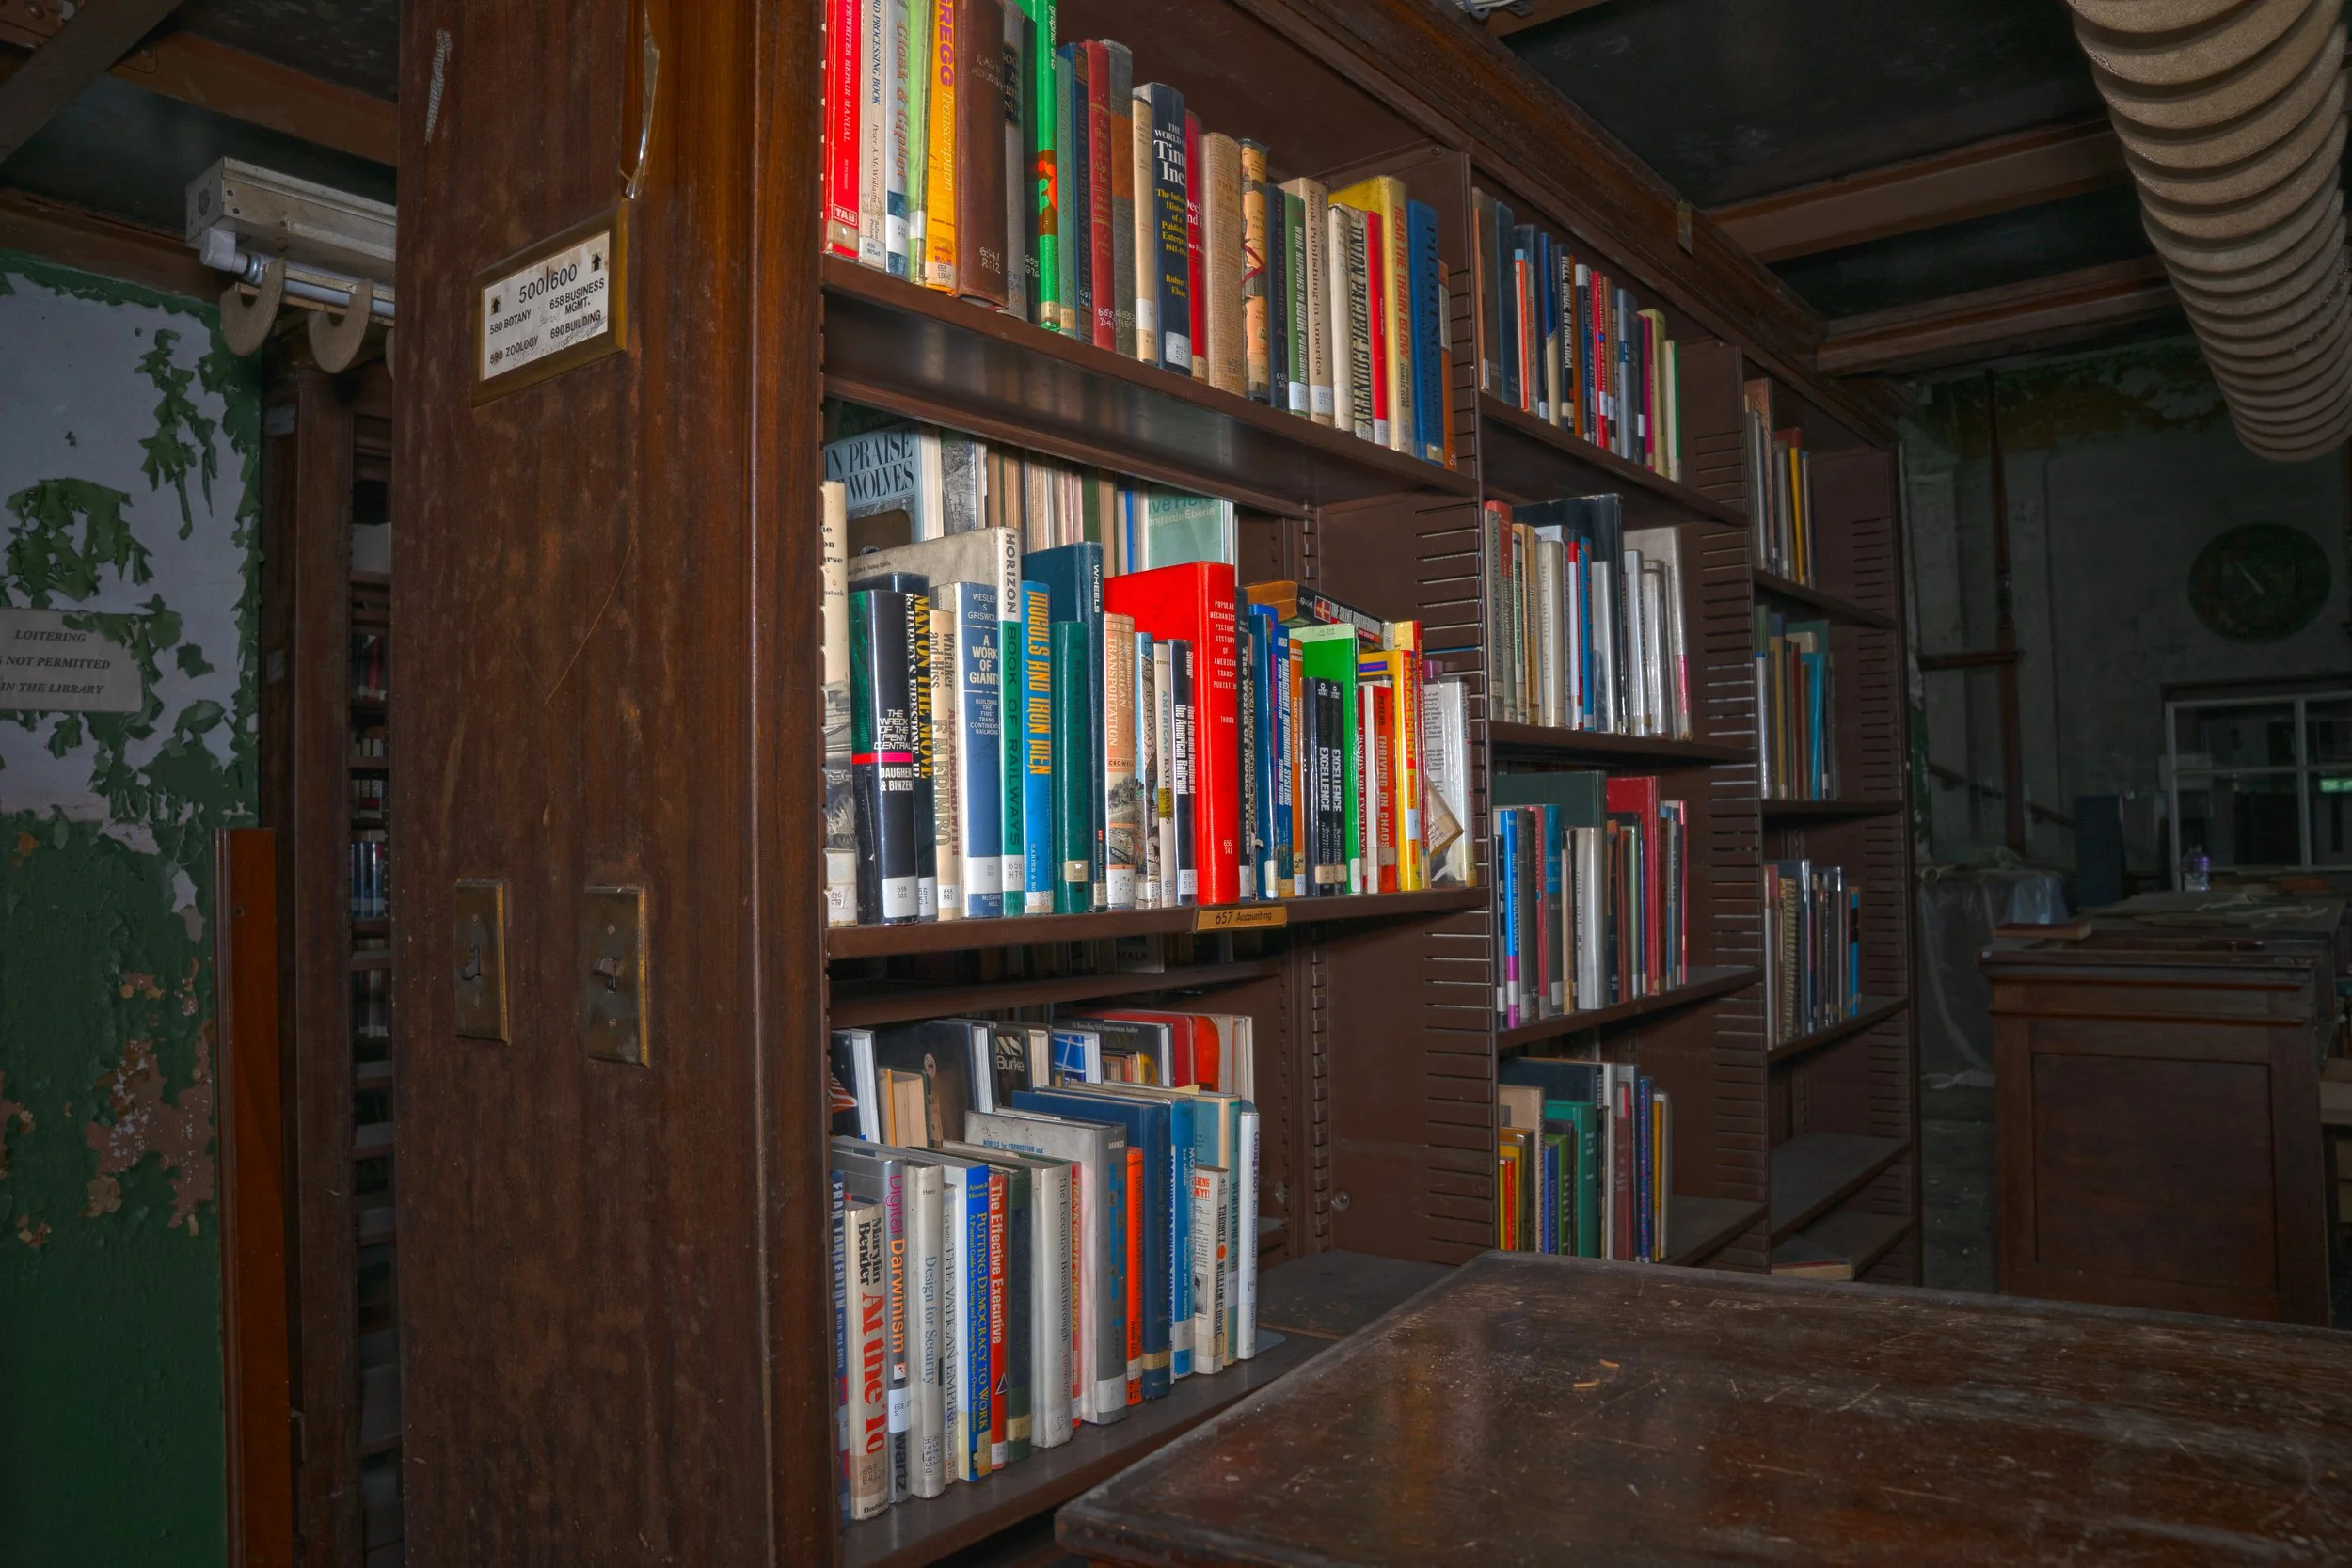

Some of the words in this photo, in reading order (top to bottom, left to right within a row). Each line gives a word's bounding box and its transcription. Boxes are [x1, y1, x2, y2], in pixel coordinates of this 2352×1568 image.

[1048, 4, 1058, 46] graphic
[872, 16, 882, 76] PROCESSING
[896, 22, 909, 84] Cloak
[871, 76, 882, 105] BOOK
[896, 87, 909, 105] &
[843, 101, 851, 142] MANUAL
[871, 123, 880, 144] Peter
[1154, 129, 1182, 145] WORLD
[1167, 122, 1182, 135] THE
[940, 92, 954, 191] Transcription
[1156, 188, 1169, 199] The
[834, 206, 857, 223] TAB
[1394, 206, 1406, 245] HEAR
[1295, 225, 1304, 249] WHAT
[1350, 226, 1367, 279] UNION
[1295, 250, 1305, 291] HAPPENS
[1311, 226, 1320, 298] Publishing
[1395, 245, 1406, 272] THE
[1562, 256, 1571, 281] WELL
[549, 296, 564, 310] 658
[565, 278, 604, 303] BUSINESS
[565, 297, 591, 315] MGMT.
[1351, 279, 1370, 345] PACIFIC
[1396, 272, 1408, 318] TRAIN
[1563, 283, 1572, 310] MADE
[489, 321, 503, 336] 580
[504, 309, 532, 329] BOTANY
[549, 325, 564, 340] 690
[565, 310, 601, 334] BUILDING
[1296, 301, 1307, 331] BOOK
[489, 350, 503, 365] 590
[505, 335, 539, 358] ZOOLOGY
[1298, 331, 1308, 384] PUBLISHING
[1397, 319, 1409, 360] BLOW
[1354, 347, 1373, 430] COUNTRY
[825, 445, 843, 482] IN
[849, 428, 913, 472] PRAISE
[849, 460, 915, 502] WOLVES
[1184, 507, 1216, 520] Eberle
[1006, 532, 1017, 614] HORIZON
[914, 594, 930, 634] MAN
[972, 592, 996, 604] WESLEY
[1210, 610, 1235, 622] MECHANICS
[1214, 600, 1234, 610] POPULAR
[14, 630, 87, 642] LOITERING
[983, 634, 990, 645] A
[1026, 590, 1050, 657] MOGULS
[1215, 623, 1235, 632] PICTURE
[1215, 635, 1235, 644] HISTORY
[6, 656, 35, 667] NOT
[37, 657, 111, 669] PERMITTED
[916, 638, 930, 668] ON
[930, 631, 940, 657] and
[943, 632, 956, 690] Whitaker
[972, 646, 997, 659] WORK
[1007, 626, 1017, 686] BOOK
[931, 660, 940, 689] Hiss
[979, 658, 992, 671] OF
[1026, 659, 1050, 692] AND
[1118, 637, 1127, 708] AMERICAN
[1186, 650, 1195, 679] Stover
[1217, 669, 1234, 677] TRANS-
[0, 682, 16, 691] IN
[19, 682, 46, 693] THE
[49, 684, 104, 694] LIBRARY
[917, 675, 933, 717] THE
[1106, 637, 1118, 746] TRANSPORTATION
[1243, 678, 1251, 726] World
[1281, 657, 1291, 712] MANAGEMENT
[879, 717, 909, 726] WRECK
[887, 708, 904, 718] THE
[1008, 699, 1018, 726] OF
[1026, 697, 1051, 734] IRON
[1144, 689, 1154, 758] RAILWAYS
[1175, 705, 1187, 718] the
[1405, 657, 1417, 762] MANAGEMENT
[873, 741, 912, 751] CENTRAL
[880, 726, 893, 735] OF
[894, 725, 909, 734] THE
[882, 734, 907, 742] PENN
[1175, 719, 1188, 758] American
[1282, 713, 1292, 768] INFORMATION
[920, 722, 934, 780] MOVE
[1027, 739, 1051, 775] MEN
[1378, 734, 1388, 788] THRIVING
[880, 782, 886, 791] &
[949, 743, 958, 812] ABOARD
[1176, 759, 1189, 795] Railroad
[1243, 747, 1251, 797] Model
[1284, 768, 1293, 806] SYSTEMS
[1320, 747, 1330, 812] EXCELLENCE
[1331, 749, 1342, 813] EXCELLENCE
[1008, 738, 1021, 846] RAILWAYS
[1379, 790, 1389, 808] ON
[1380, 808, 1390, 848] CHAOS
[1009, 862, 1024, 870] 656
[1215, 911, 1234, 925] 657
[1235, 911, 1272, 922] Accounting
[997, 1055, 1025, 1072] Burke
[832, 1182, 844, 1220] FRAN
[886, 1175, 904, 1236] Digital
[991, 1182, 1003, 1210] The
[1059, 1200, 1068, 1256] Executive
[1218, 1204, 1227, 1237] THEORY
[858, 1220, 870, 1287] Bender
[871, 1217, 882, 1284] Marylin
[977, 1212, 987, 1274] PUTTING
[991, 1214, 1004, 1275] Effective
[833, 1225, 846, 1308] TARKENTON
[922, 1257, 938, 1302] Design
[945, 1243, 955, 1283] THE
[1216, 1260, 1225, 1302] WILLIAM
[862, 1292, 886, 1337] At
[890, 1238, 907, 1354] Darwinism
[925, 1304, 938, 1322] for
[991, 1278, 1004, 1344] Executive
[1060, 1259, 1069, 1343] Breakthrough
[946, 1285, 957, 1359] VATICAN
[977, 1276, 988, 1362] DEMOCRACY
[863, 1337, 888, 1404] the
[923, 1327, 939, 1386] Security
[978, 1367, 988, 1385] TO
[946, 1364, 958, 1429] EMPIRE
[978, 1386, 989, 1430] WORK
[893, 1433, 908, 1494] wartz
